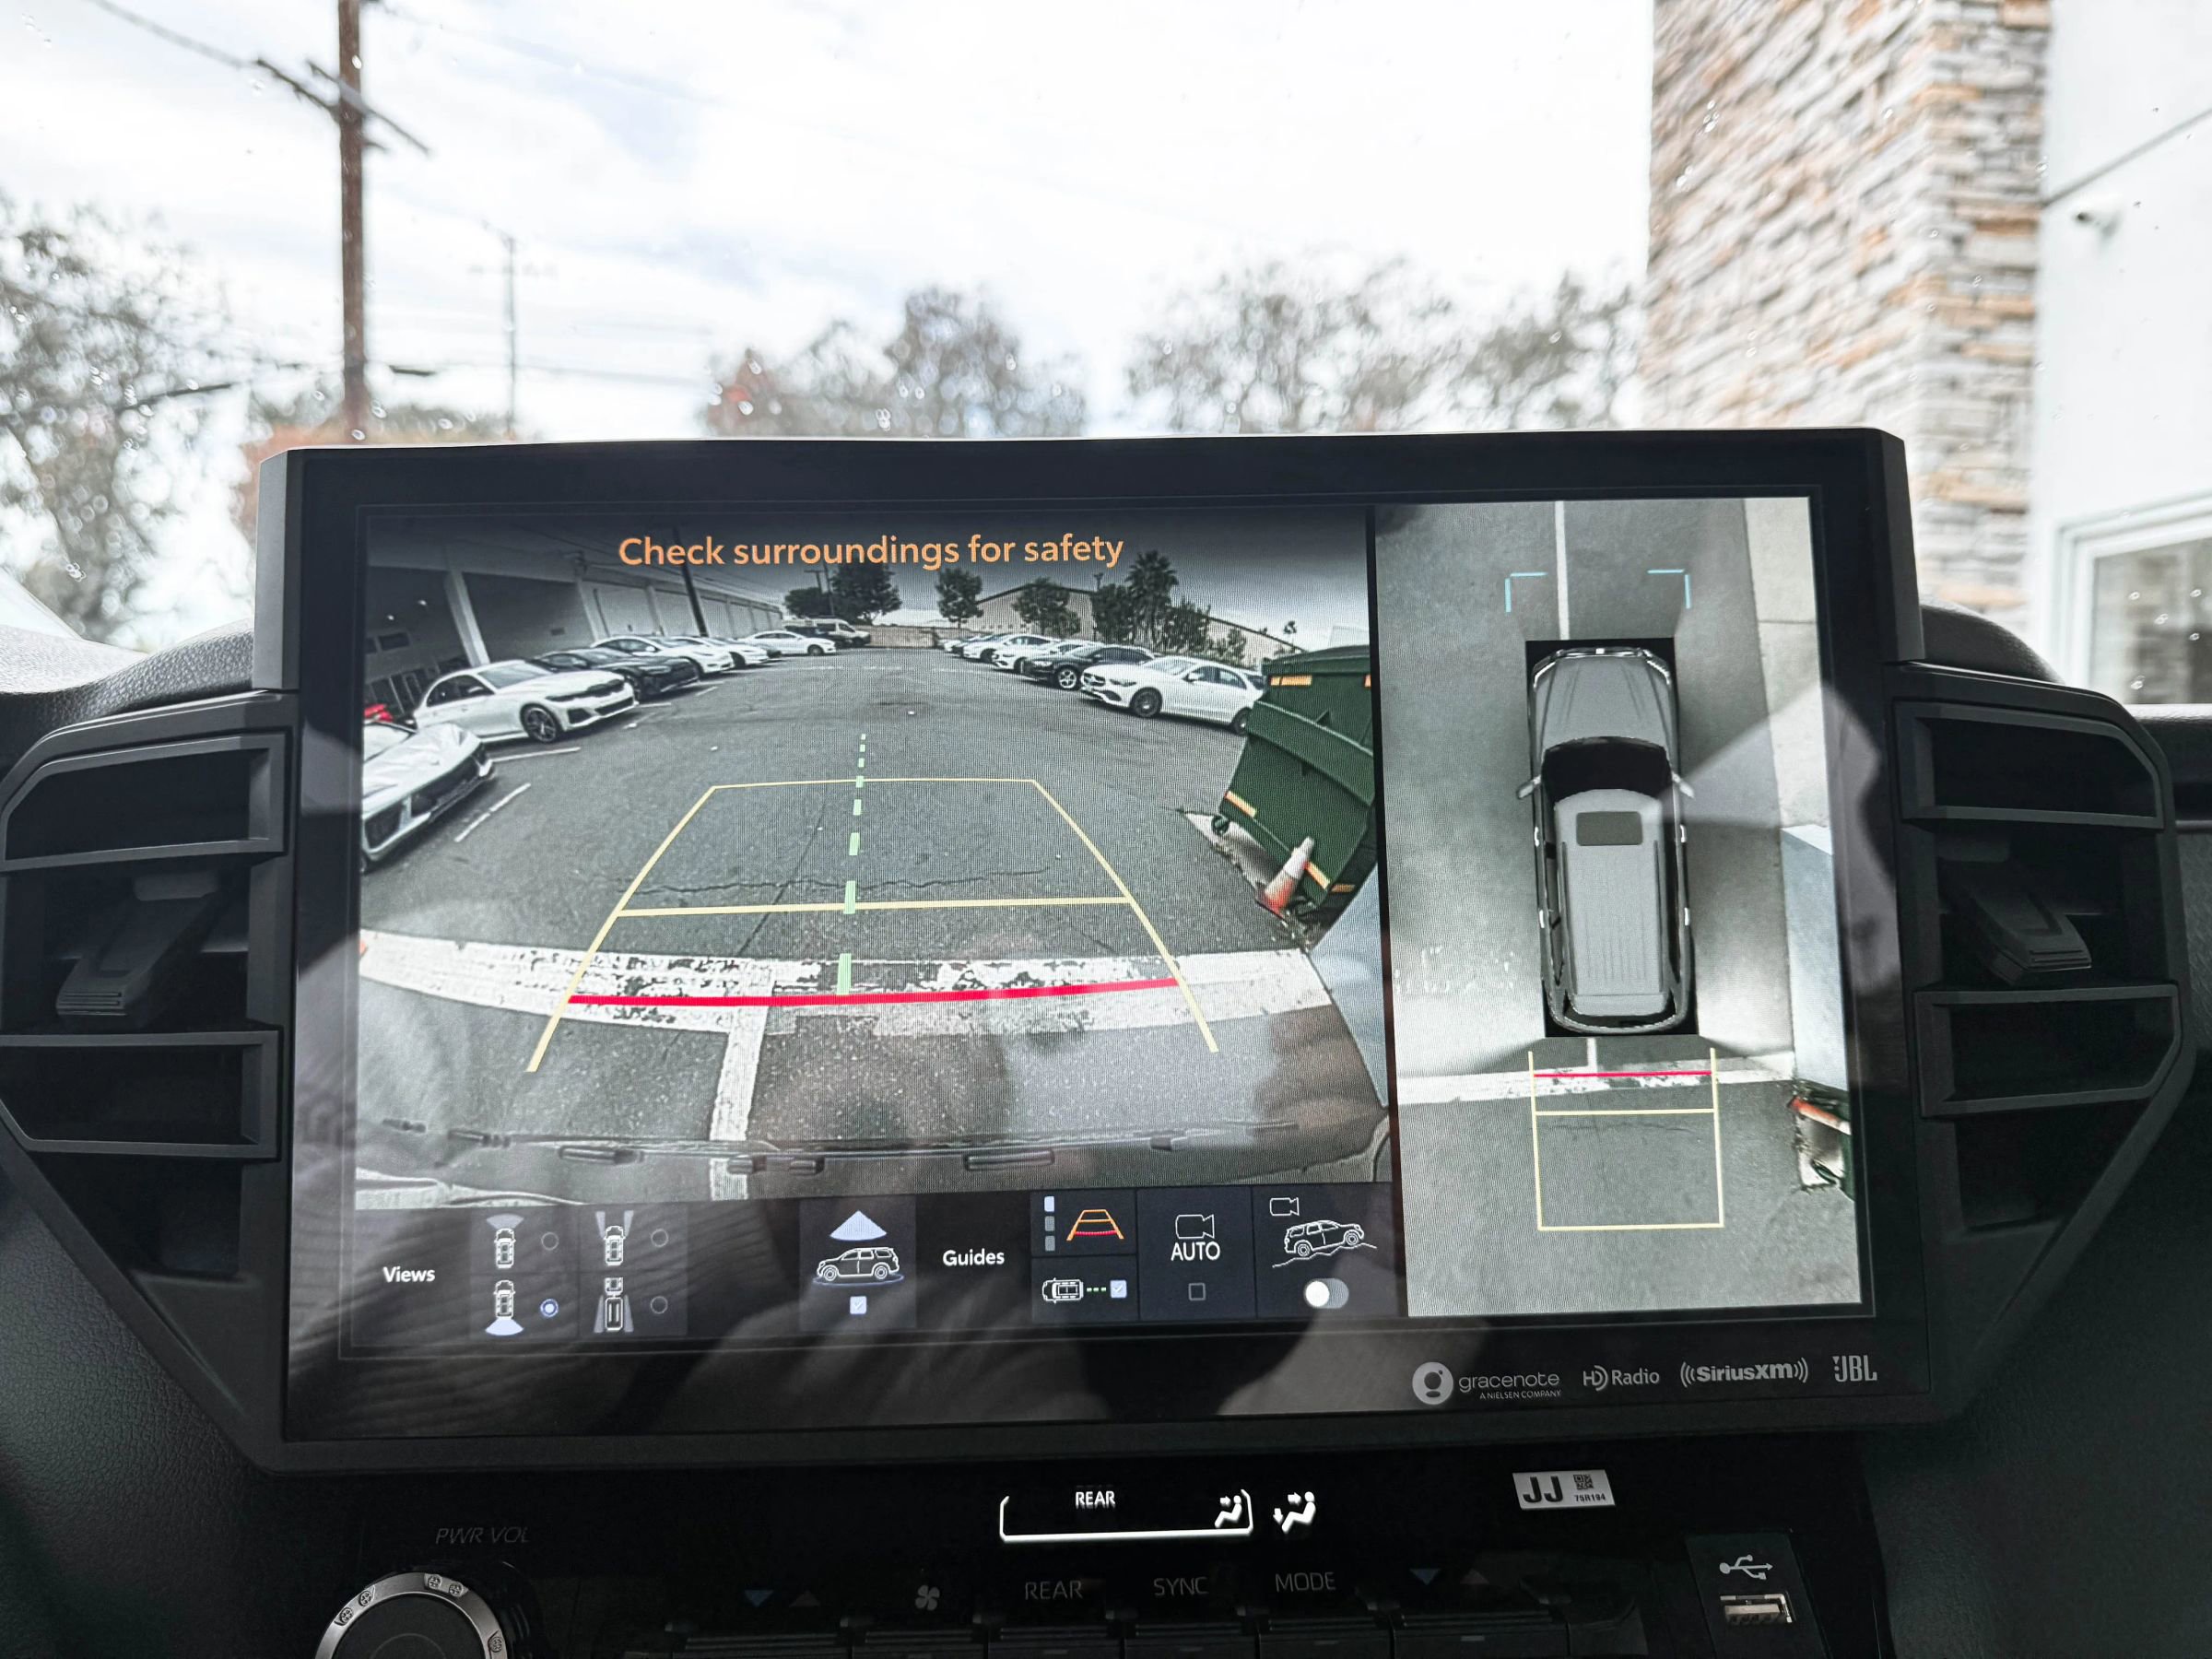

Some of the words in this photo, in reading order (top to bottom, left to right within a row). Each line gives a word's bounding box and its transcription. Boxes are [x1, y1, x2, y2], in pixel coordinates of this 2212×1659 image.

[618, 535, 724, 566] Check
[734, 535, 959, 571] surroundings
[968, 534, 1015, 564] for
[1024, 533, 1124, 569] safety
[942, 1248, 1006, 1268] Guides
[1171, 1241, 1221, 1263] AUTO
[382, 1265, 436, 1284] Views
[1612, 1368, 1660, 1386] Radio
[1832, 1354, 1878, 1382] JBL
[1458, 1371, 1560, 1394] gracenote
[1479, 1392, 1487, 1400] A
[1487, 1390, 1520, 1400] NIELSEN
[1521, 1389, 1561, 1399] COMPANY
[1074, 1490, 1116, 1509] REAR
[1522, 1476, 1564, 1503] JJ
[435, 1526, 484, 1545] PWR
[491, 1526, 531, 1544] VOL
[1025, 1580, 1084, 1601] REAR
[1153, 1576, 1209, 1598] SYNC
[1275, 1571, 1336, 1594] MODE
